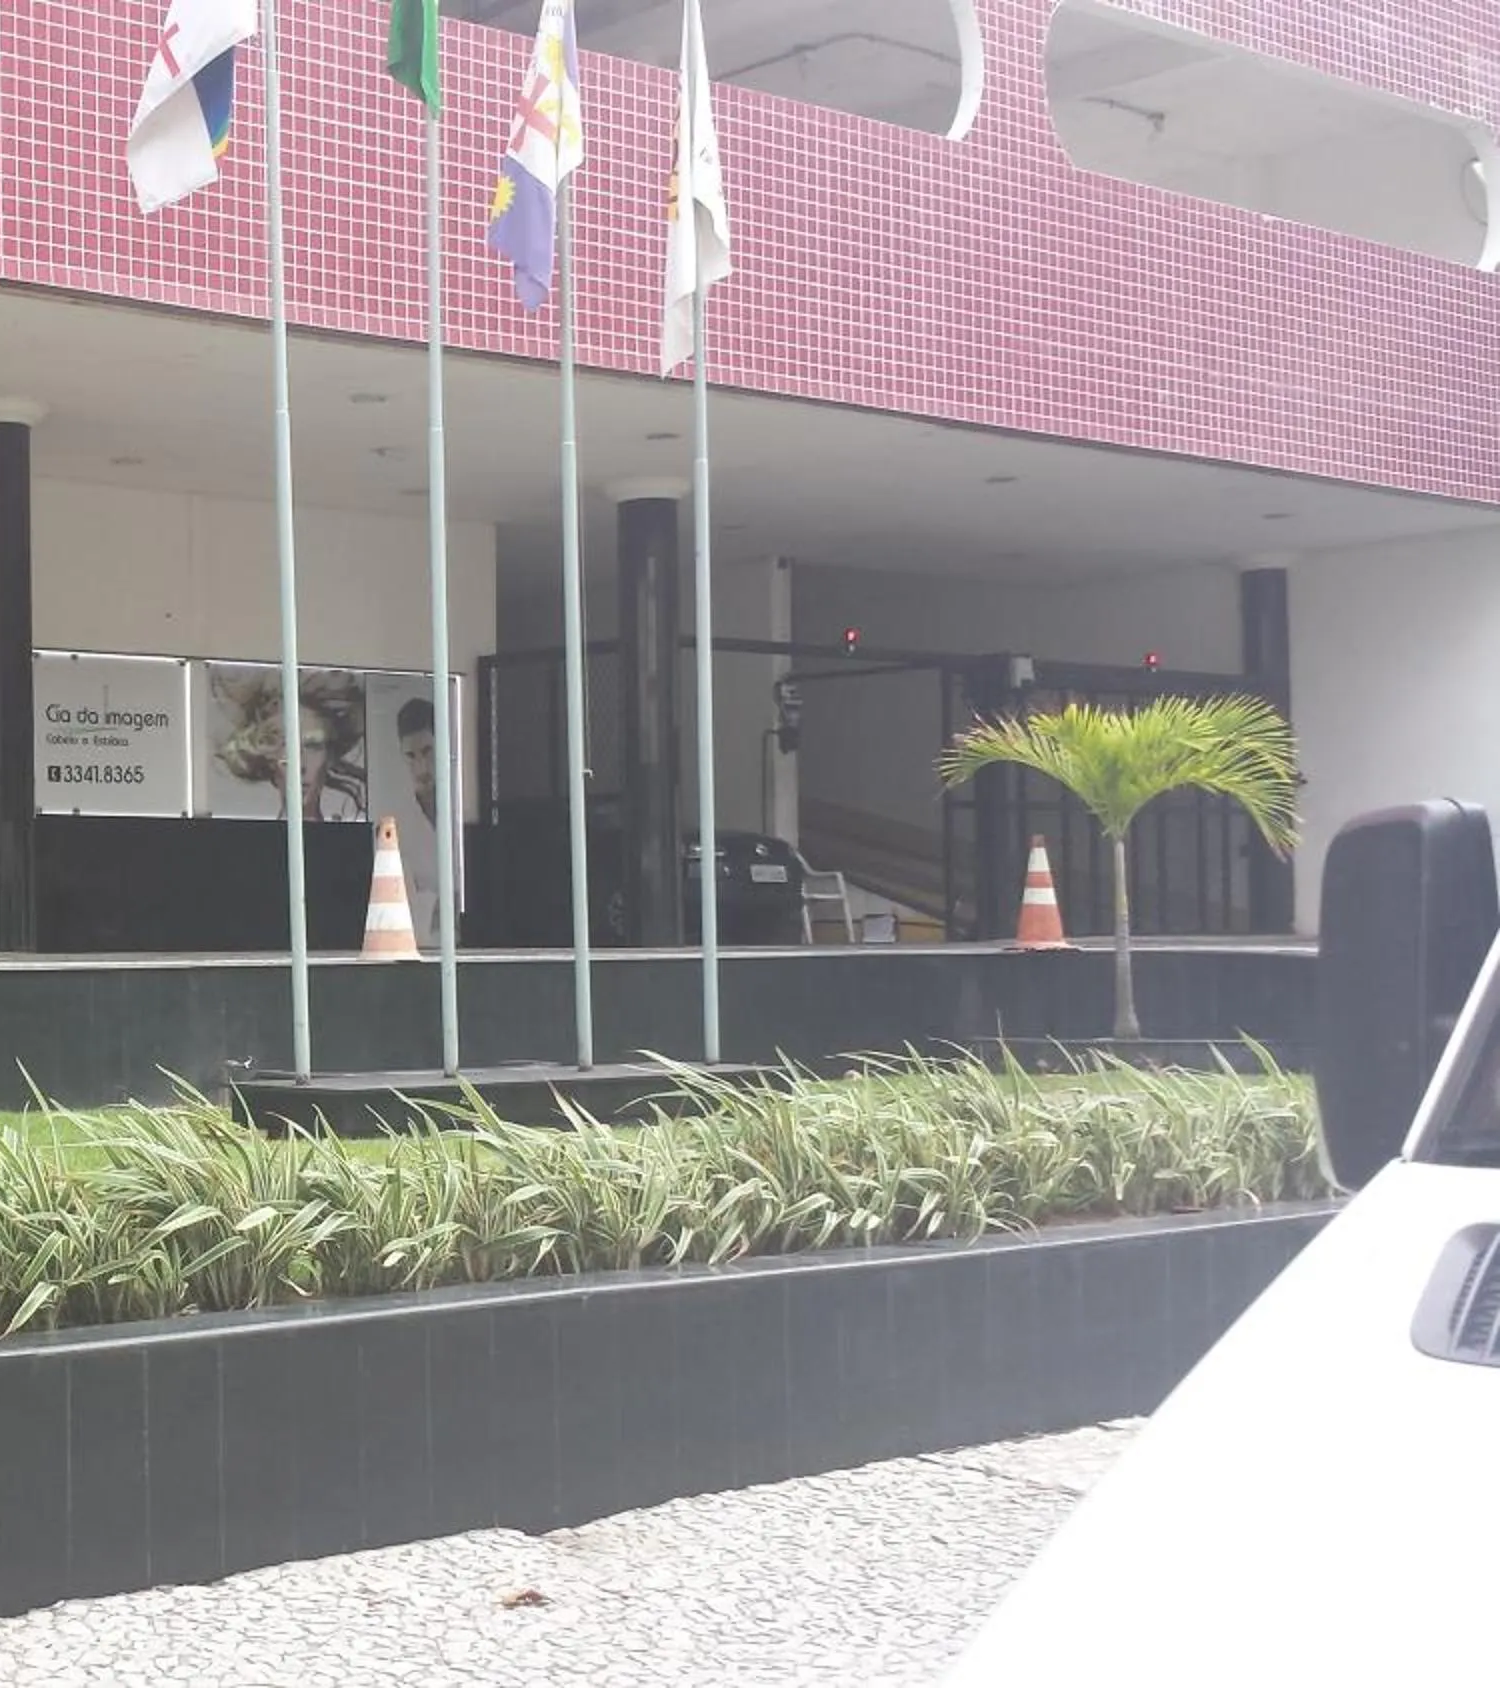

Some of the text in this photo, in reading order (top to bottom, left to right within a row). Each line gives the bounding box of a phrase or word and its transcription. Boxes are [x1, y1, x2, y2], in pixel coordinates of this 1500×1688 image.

[77, 705, 99, 724] da
[103, 704, 169, 731] imagem
[63, 764, 145, 784] 3341.8365
